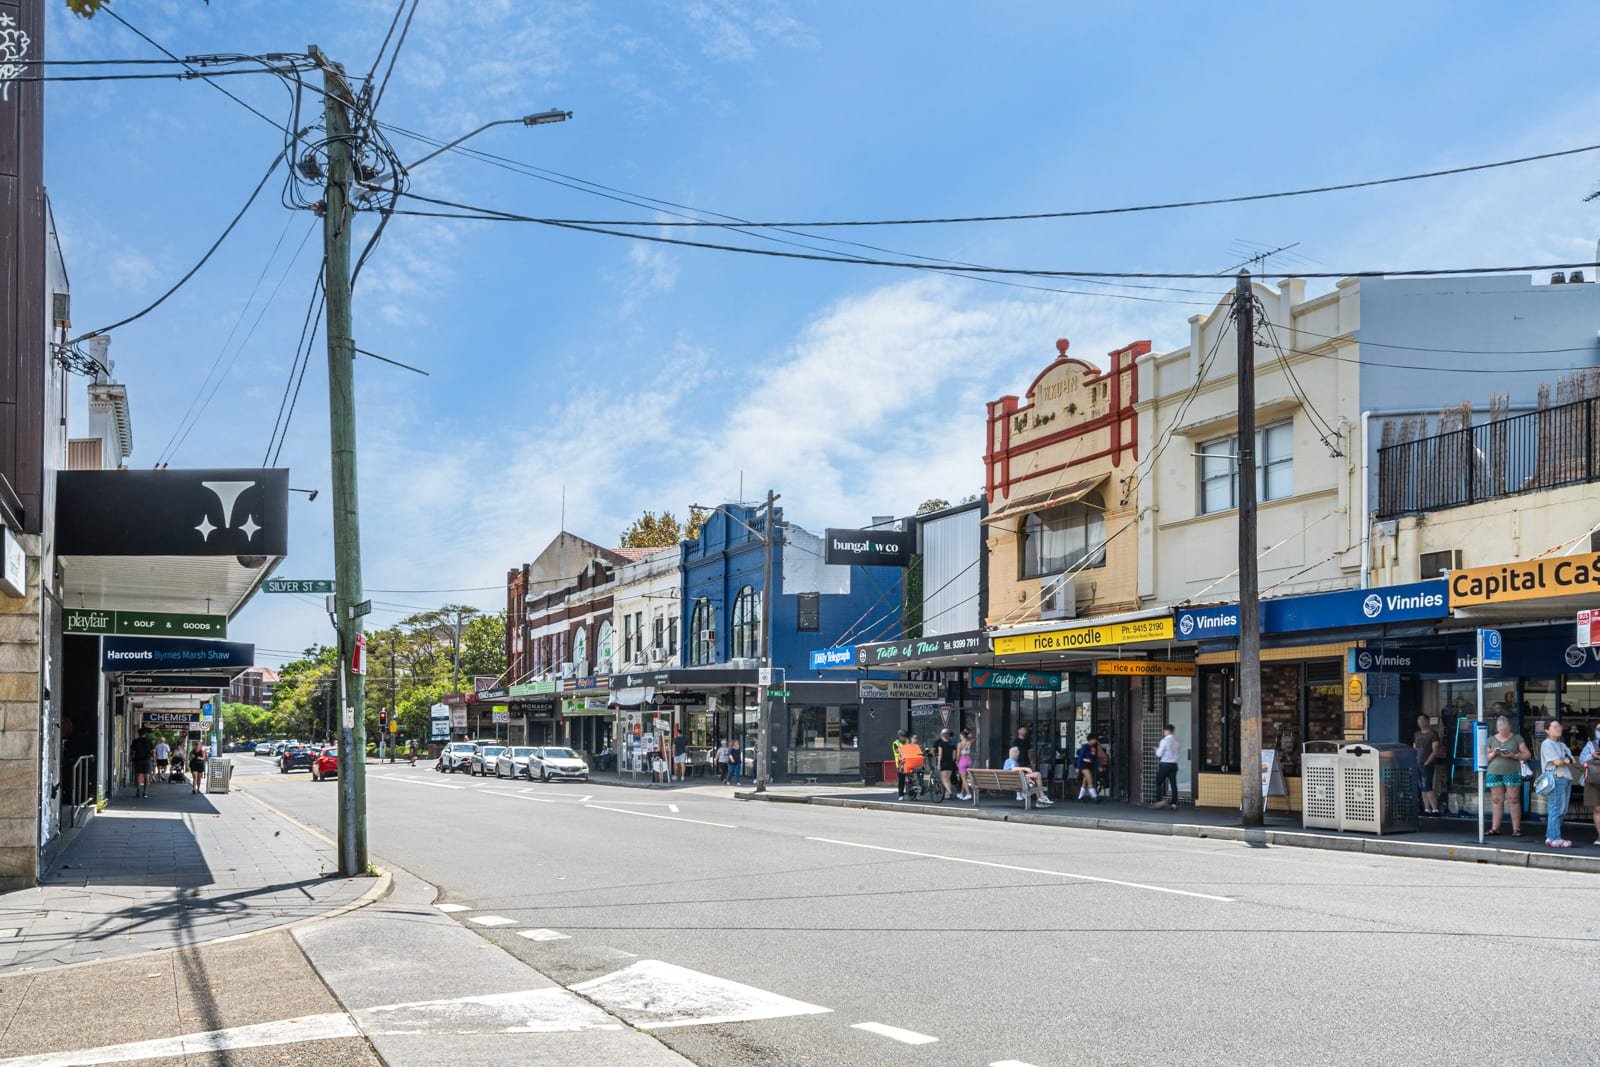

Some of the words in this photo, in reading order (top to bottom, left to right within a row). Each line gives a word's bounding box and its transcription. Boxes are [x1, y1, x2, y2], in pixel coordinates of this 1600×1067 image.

[268, 581, 299, 592] SILVER
[302, 582, 314, 591] ST
[1453, 562, 1546, 600] Capital
[1386, 592, 1443, 611] Vinnies
[68, 611, 109, 631] playfair
[134, 620, 155, 628] GOLF
[183, 622, 211, 630] GOODS
[1196, 613, 1237, 629] Vinnies
[1132, 624, 1148, 633] 9415
[1148, 622, 1164, 632] 2190
[966, 638, 980, 647] 7911
[1034, 635, 1054, 649] rice
[1055, 638, 1061, 647] &
[1063, 628, 1101, 647] noodle
[107, 650, 152, 660] Harcourts
[154, 651, 181, 661] Byrnes
[182, 651, 206, 659] Marsh
[208, 651, 230, 660] Shaw
[876, 645, 898, 660] Taste
[902, 644, 912, 656] of
[916, 641, 940, 655] Thai
[1374, 655, 1411, 666] Vinnies
[1113, 664, 1128, 672] rice
[1135, 664, 1162, 672] noodle
[991, 672, 1014, 685] Taste
[1015, 672, 1028, 686] of
[893, 682, 934, 690] RANDWICK
[861, 689, 889, 697] Lotteries
[889, 690, 937, 698] NEWSAGENCY
[149, 713, 193, 721] CHEMIST
